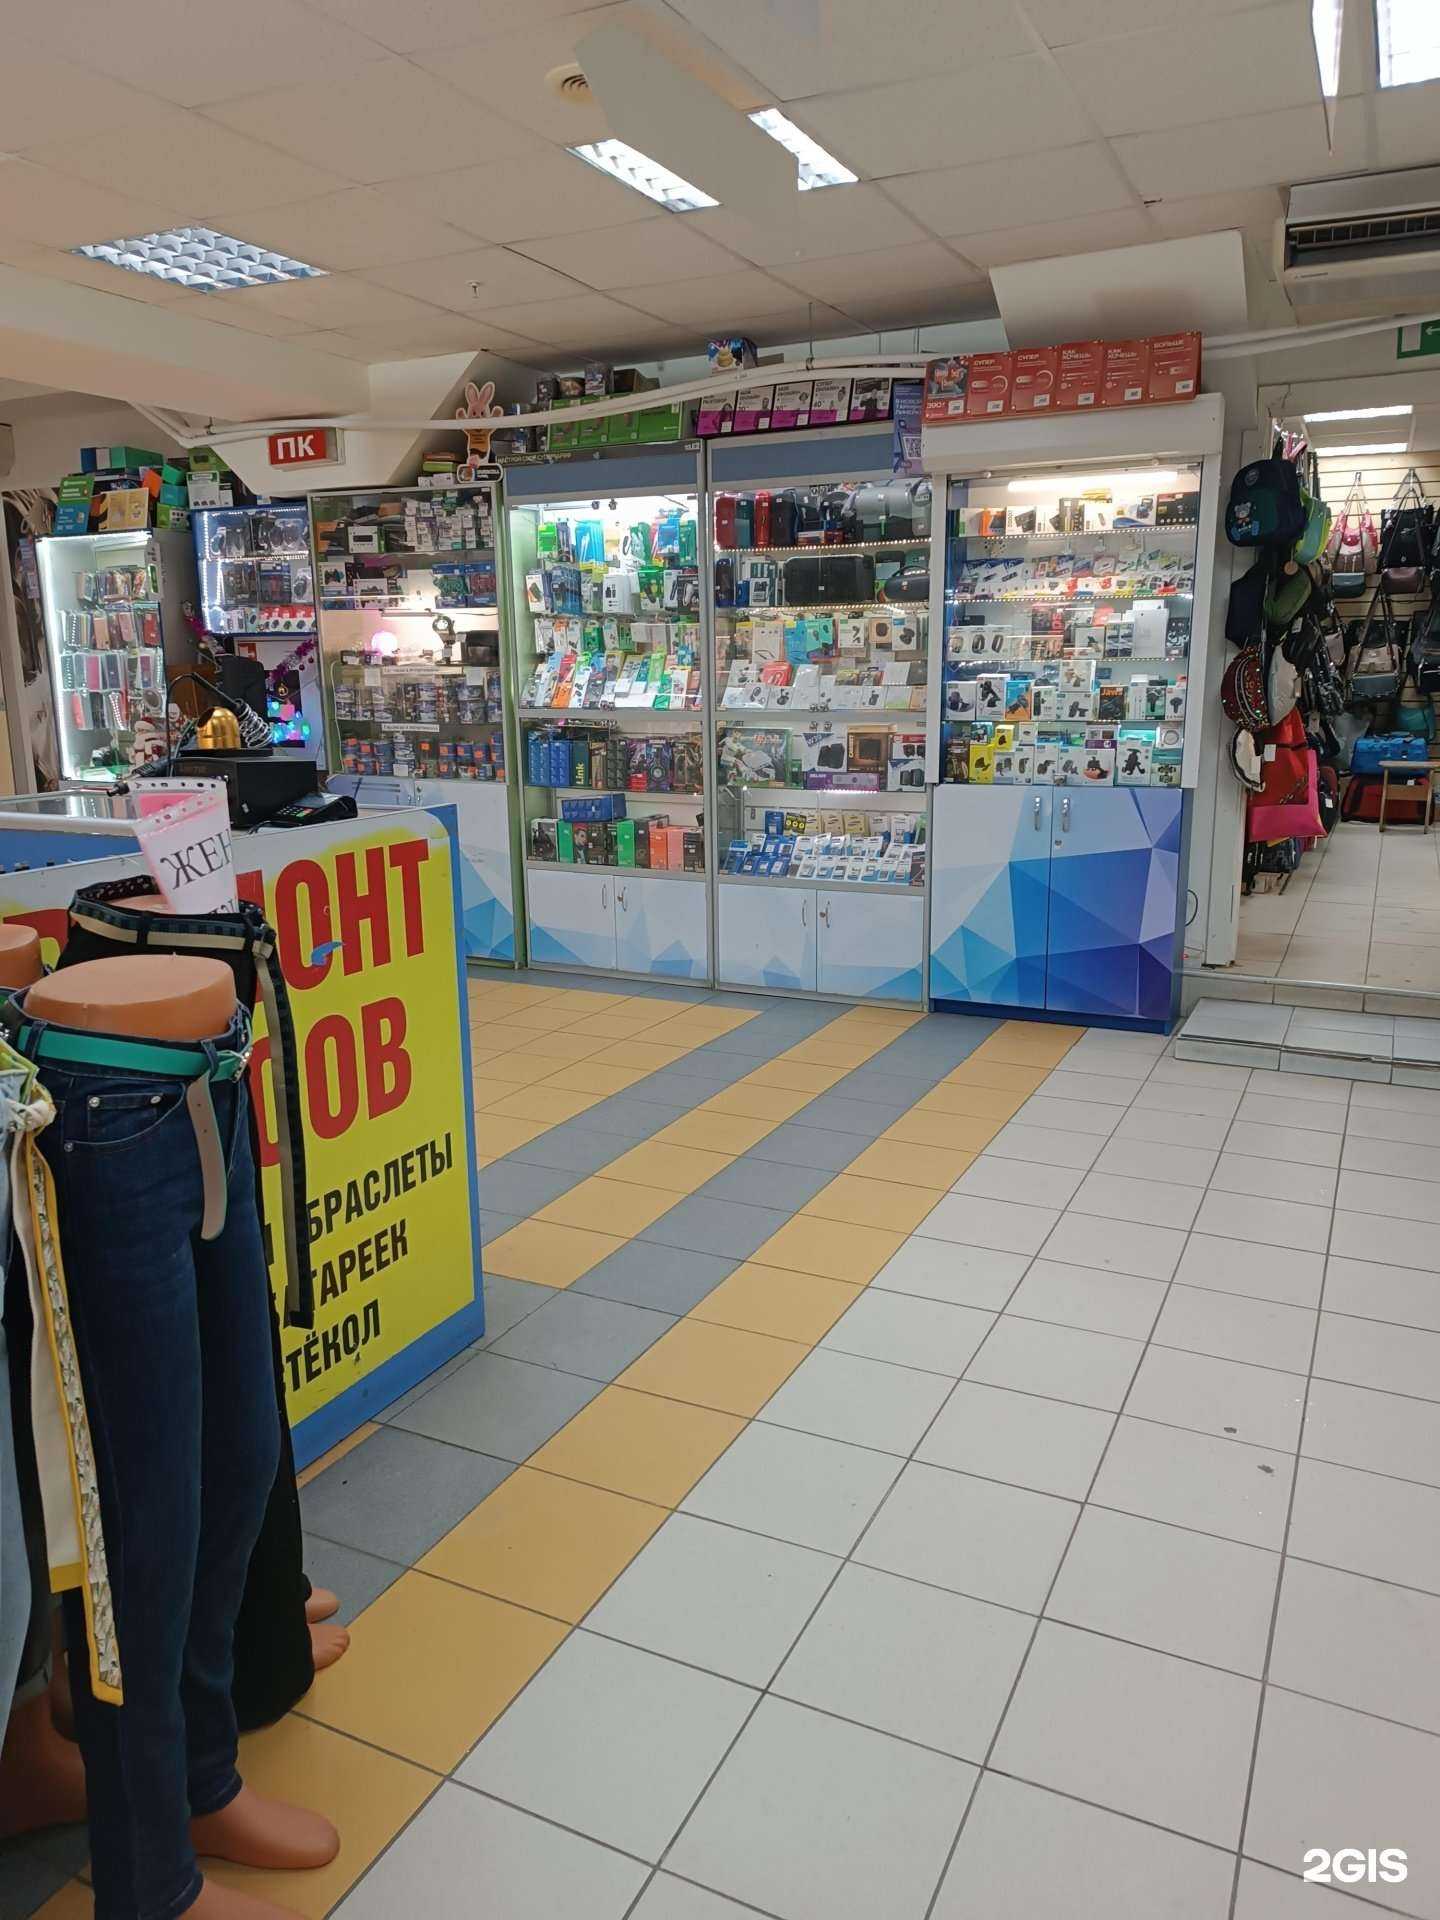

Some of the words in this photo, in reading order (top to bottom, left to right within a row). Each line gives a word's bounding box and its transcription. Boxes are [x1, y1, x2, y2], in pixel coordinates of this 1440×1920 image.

[277, 434, 315, 460] ПК
[236, 838, 430, 992] ОНТ
[306, 1132, 453, 1244] БРАСЛЕТЫ
